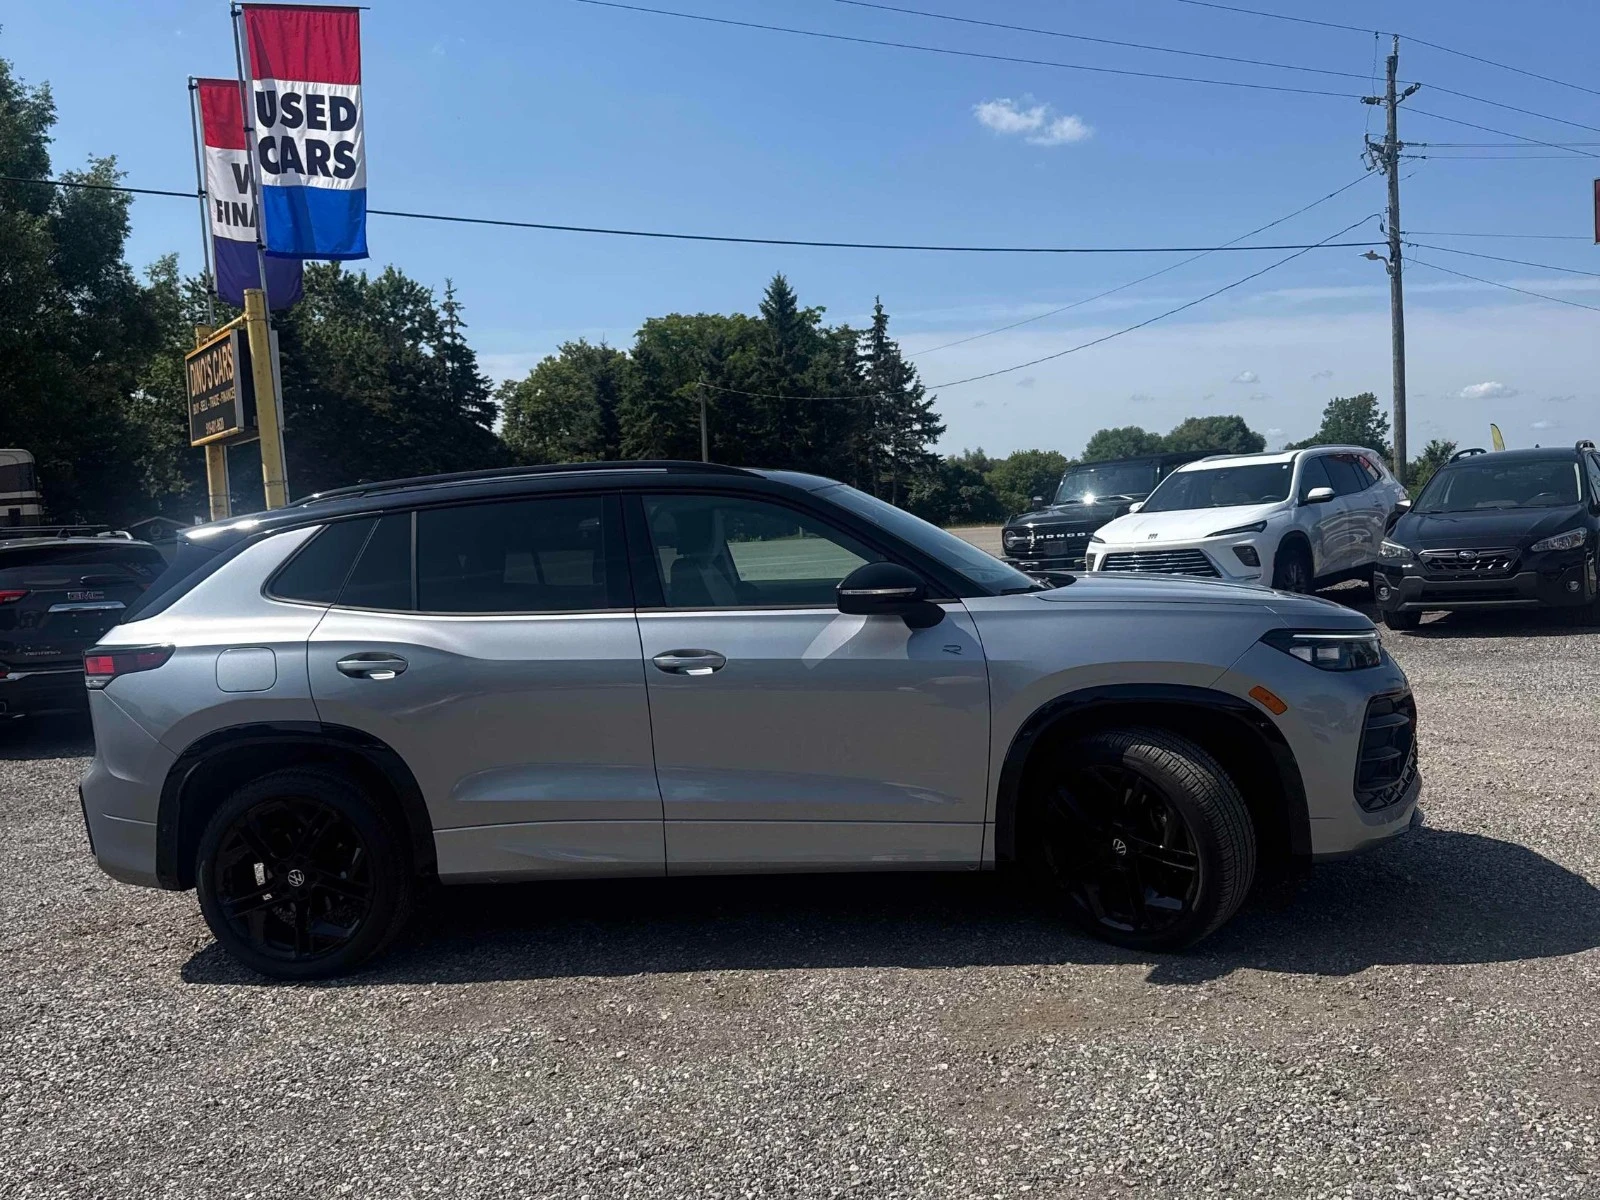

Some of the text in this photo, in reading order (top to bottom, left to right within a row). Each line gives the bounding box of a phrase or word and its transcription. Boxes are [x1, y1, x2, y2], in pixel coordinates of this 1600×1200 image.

[255, 90, 357, 132] USED
[258, 135, 356, 180] CARS
[190, 342, 234, 396] DINO'S CARS
[1027, 532, 1086, 540] BRONCO
[67, 591, 105, 601] GMC
